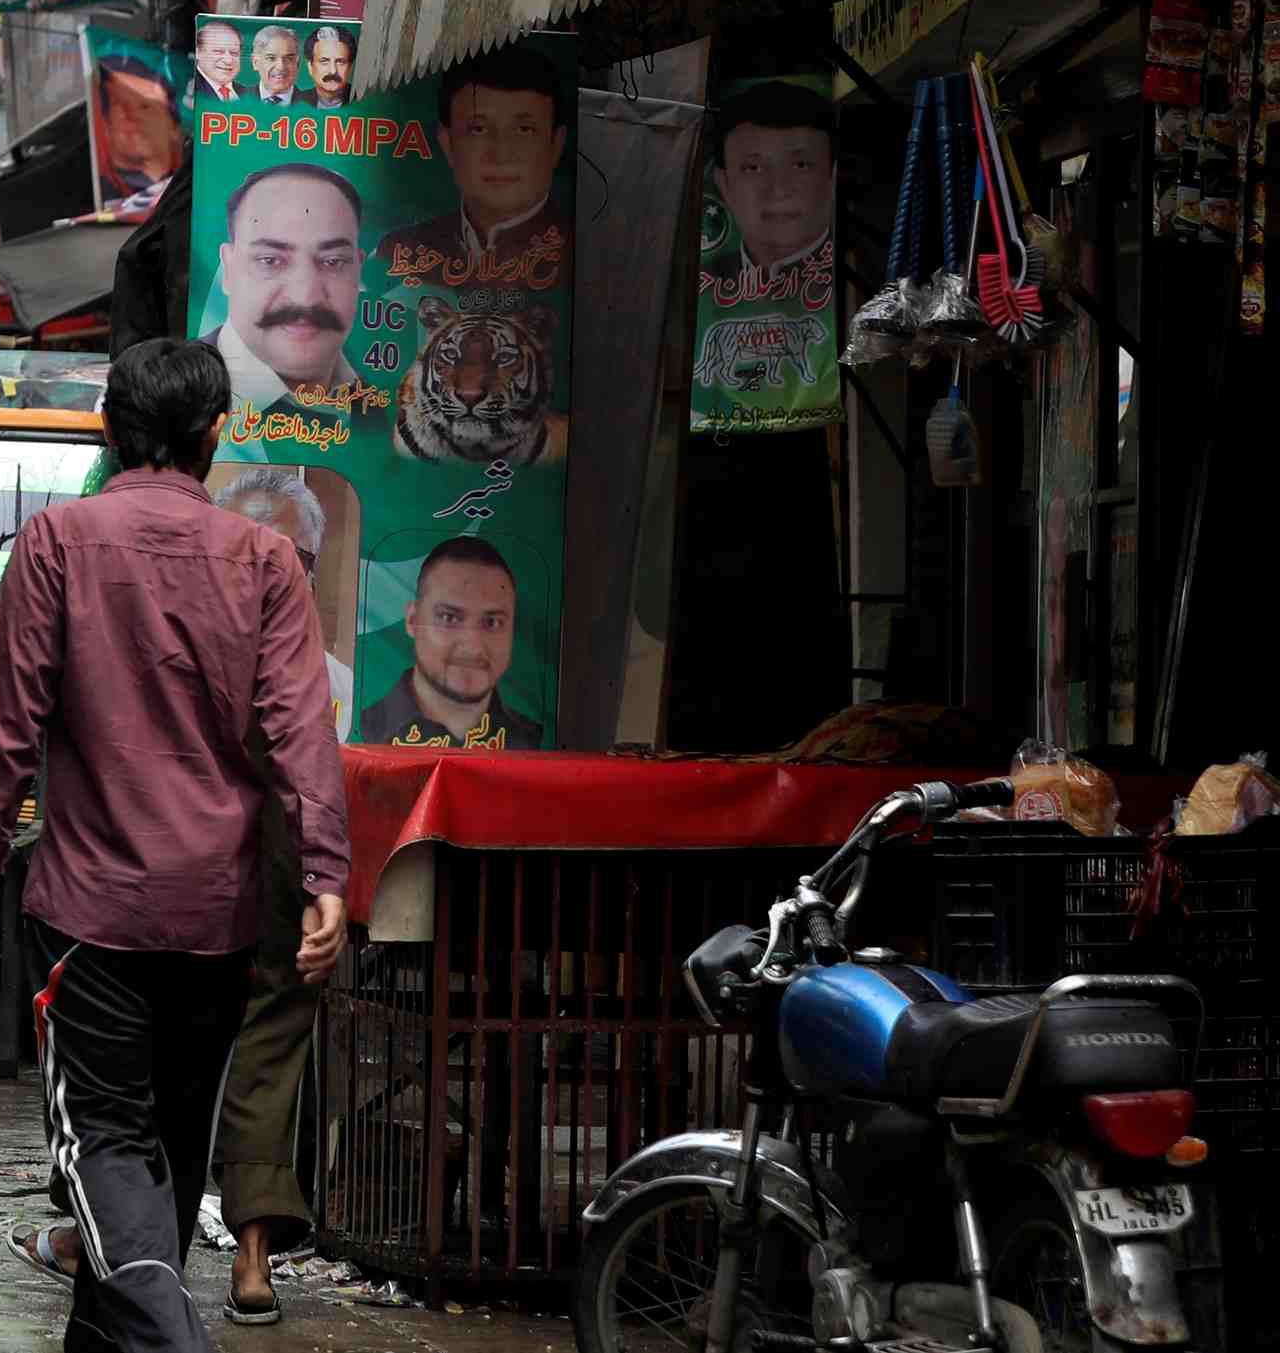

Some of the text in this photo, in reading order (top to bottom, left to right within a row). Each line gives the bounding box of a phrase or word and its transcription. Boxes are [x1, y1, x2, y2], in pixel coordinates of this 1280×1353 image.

[200, 112, 433, 160] PP-16 MPA
[387, 242, 445, 289] حفیظ
[361, 300, 408, 332] UC
[363, 341, 402, 373] 40
[432, 458, 516, 520] شیر
[1064, 1032, 1172, 1047] HONDA
[1087, 1201, 1119, 1223] HL
